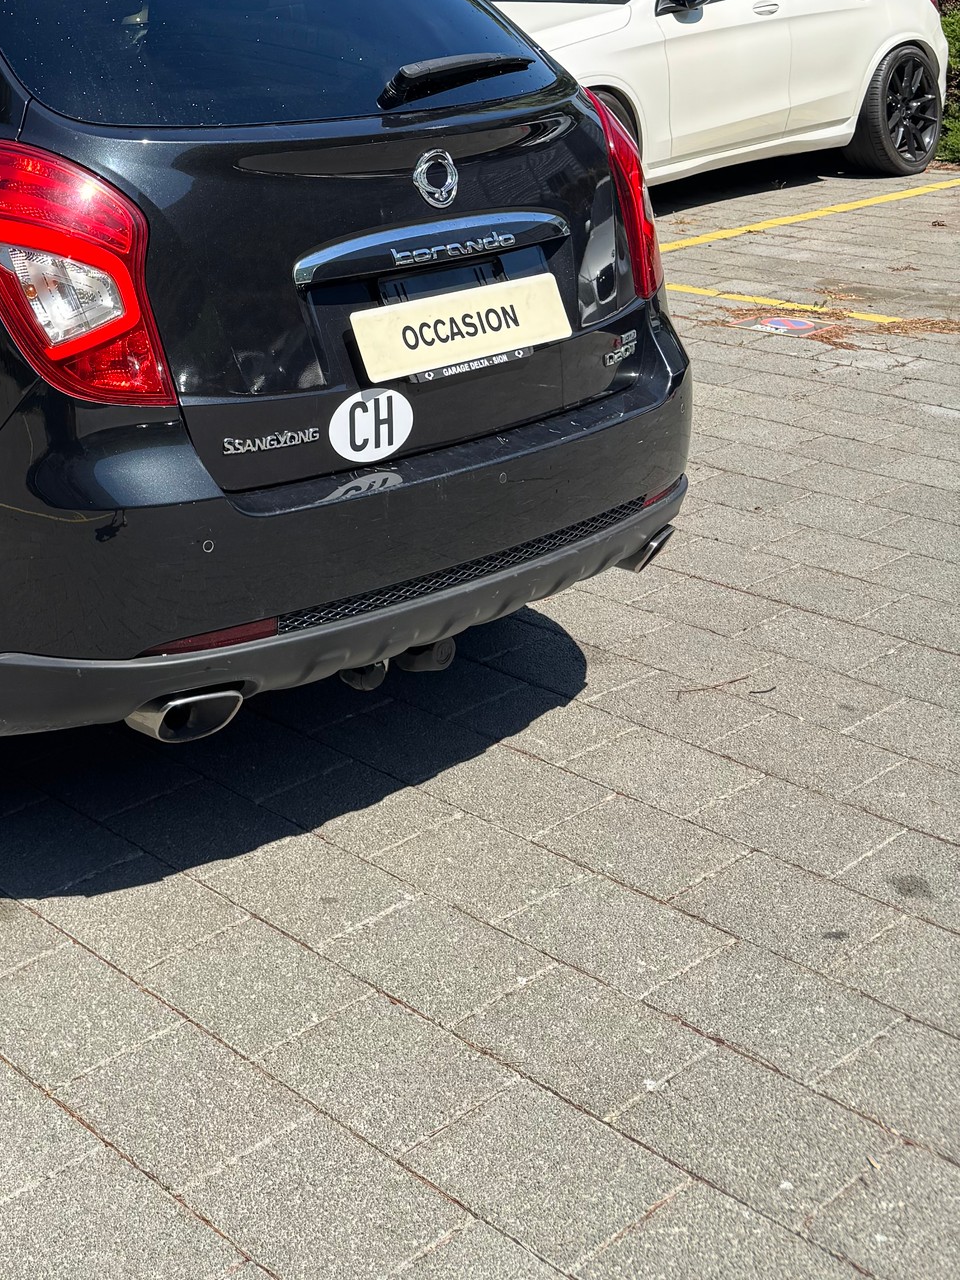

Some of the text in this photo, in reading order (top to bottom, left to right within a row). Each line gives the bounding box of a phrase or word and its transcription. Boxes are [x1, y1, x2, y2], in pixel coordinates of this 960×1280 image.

[402, 304, 520, 350] OCCASION
[442, 363, 470, 376] GARAGE
[470, 358, 490, 370] DELTA
[492, 354, 509, 365] SION
[349, 395, 394, 452] CH
